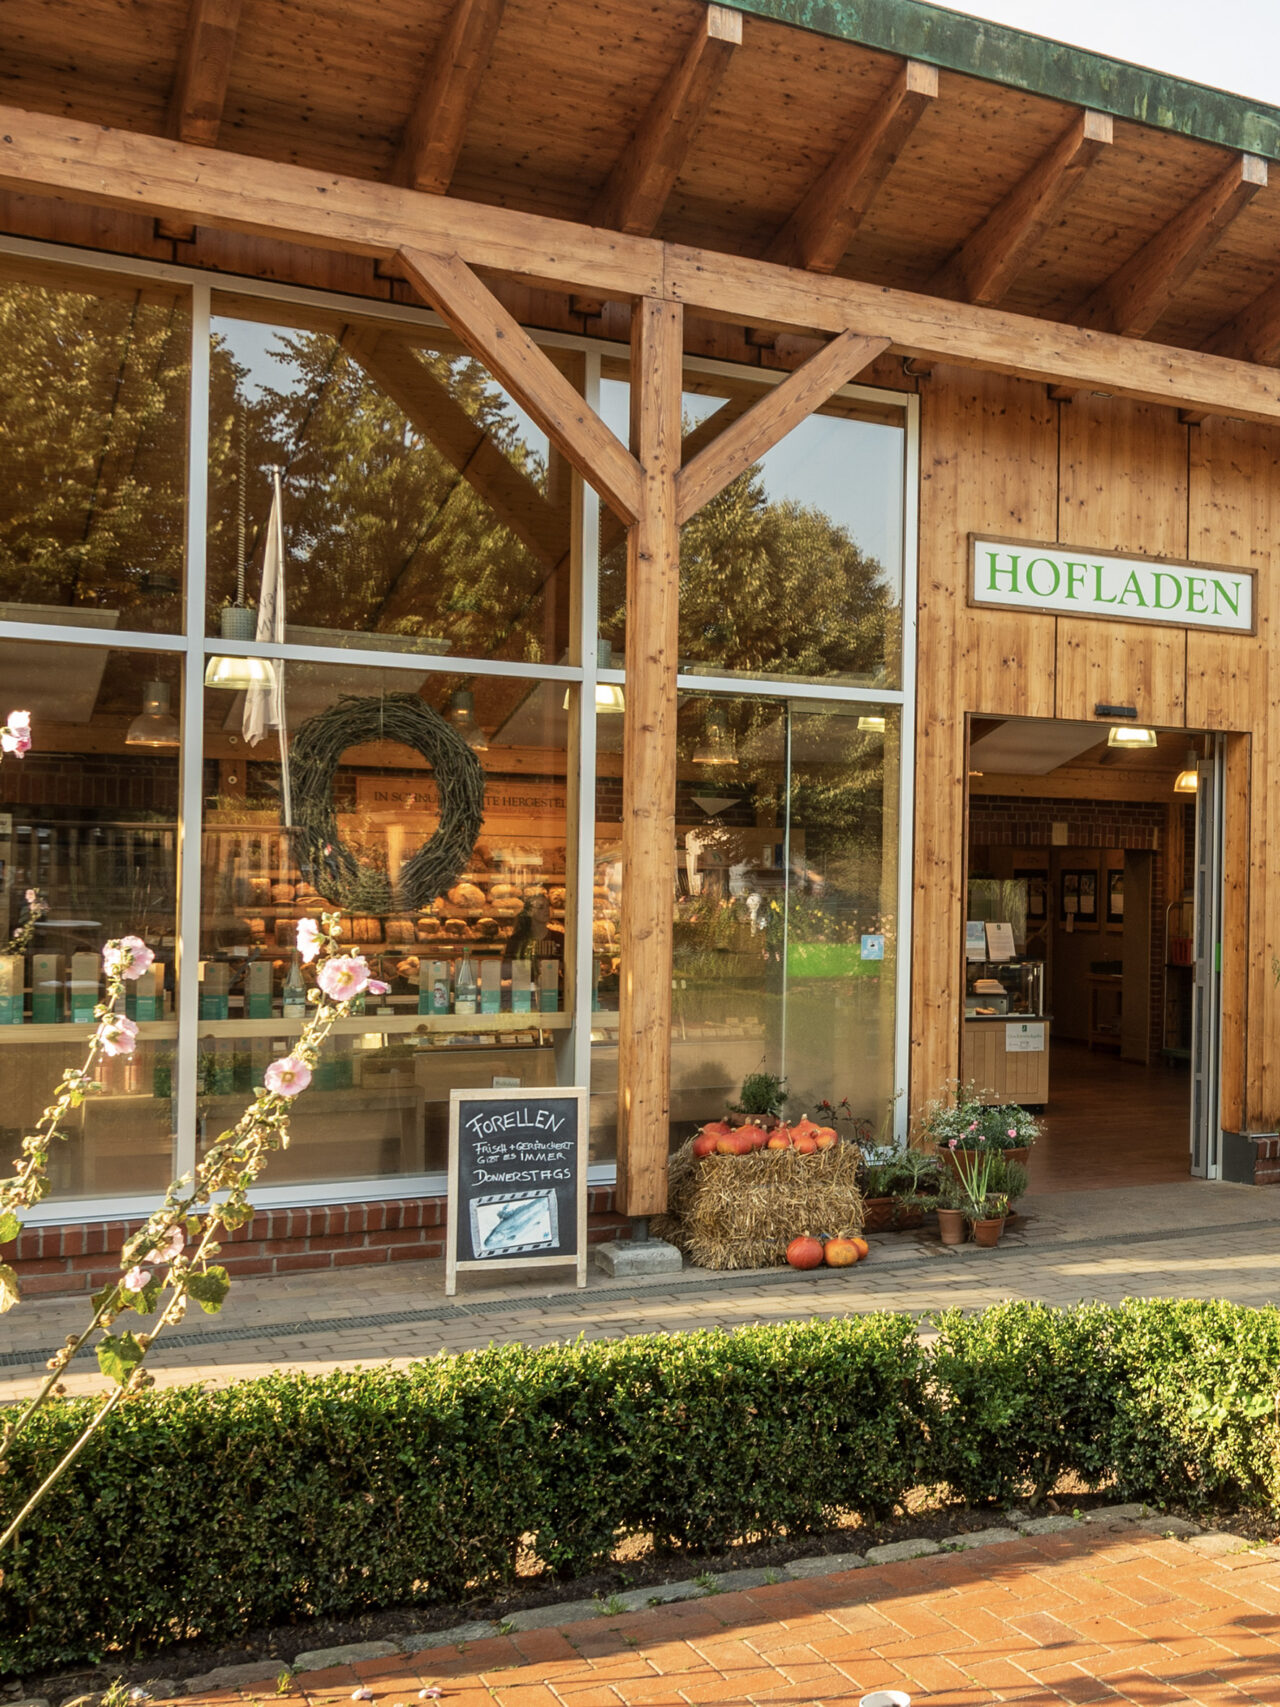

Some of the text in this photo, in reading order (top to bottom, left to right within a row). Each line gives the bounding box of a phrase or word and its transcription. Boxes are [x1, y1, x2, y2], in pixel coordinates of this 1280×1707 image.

[984, 551, 1243, 617] HOFLADEN
[374, 791, 389, 801] IN
[465, 1107, 566, 1139] FORELLEN
[471, 1168, 572, 1187] DONNERSTAGS
